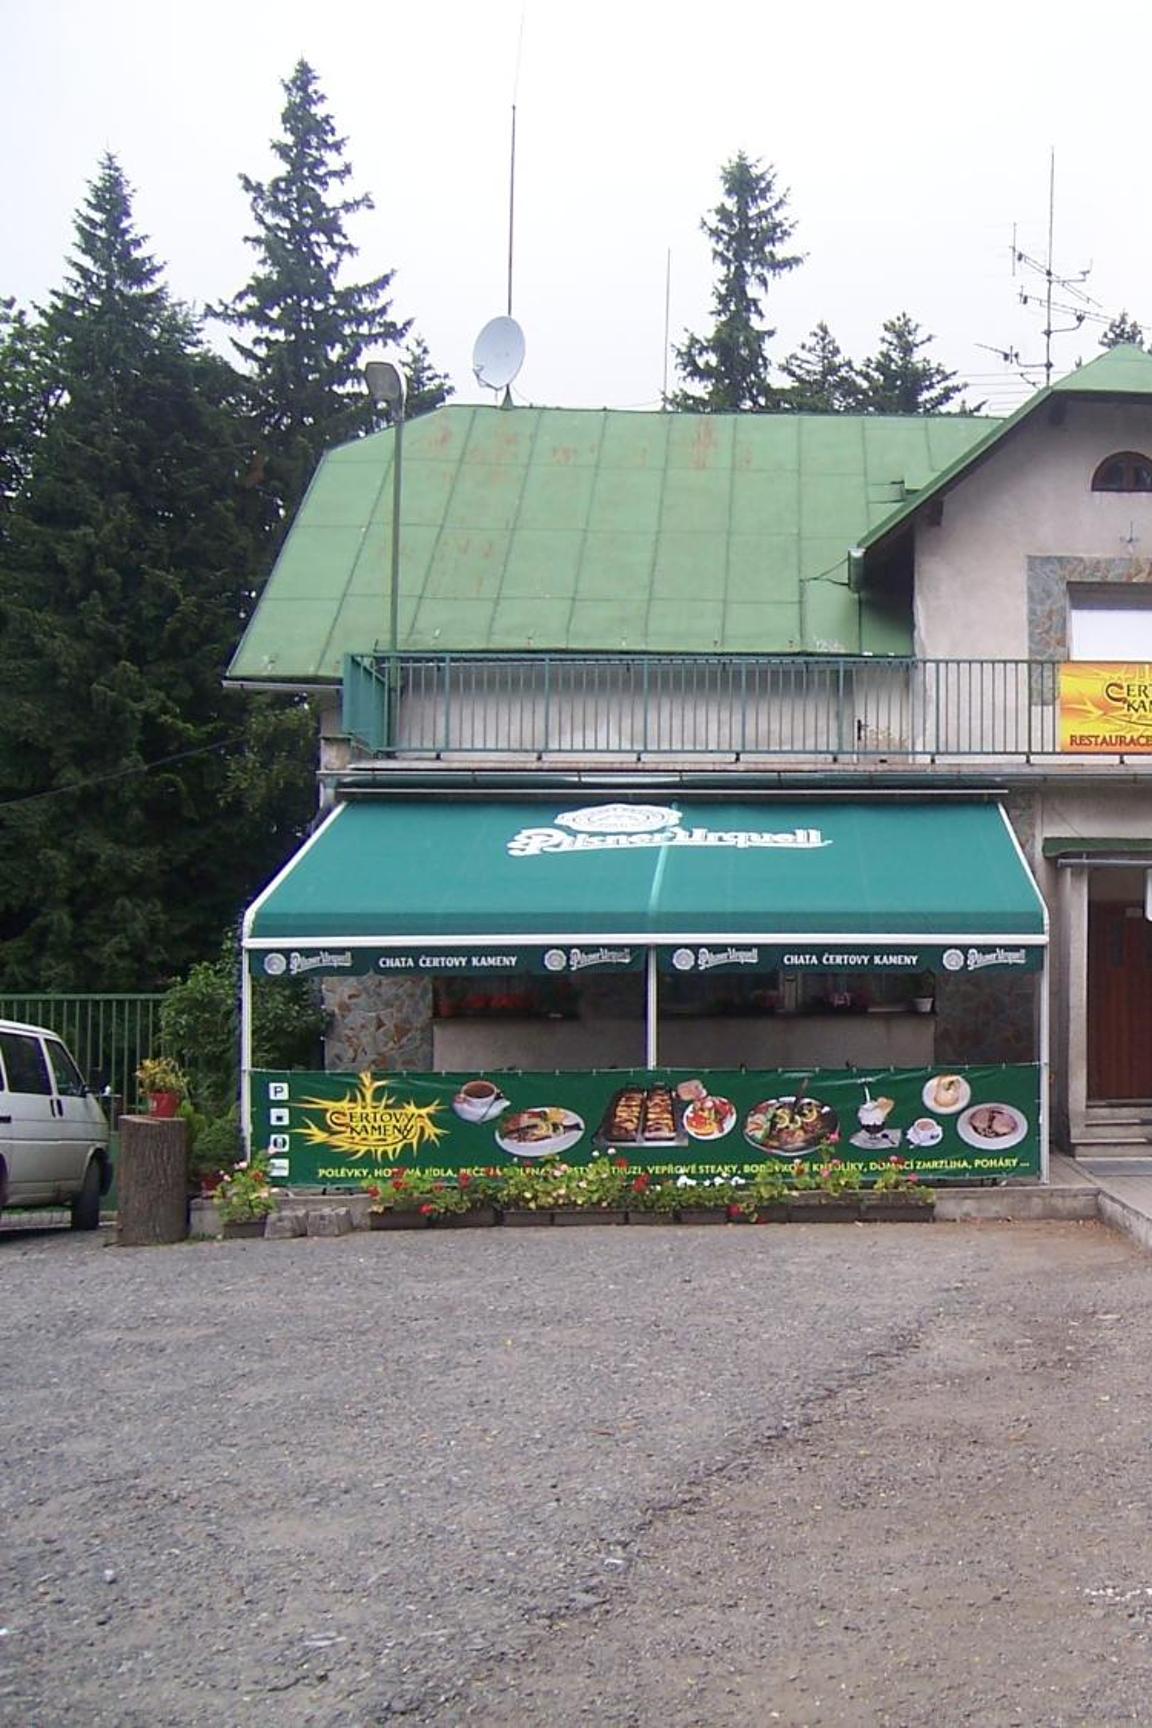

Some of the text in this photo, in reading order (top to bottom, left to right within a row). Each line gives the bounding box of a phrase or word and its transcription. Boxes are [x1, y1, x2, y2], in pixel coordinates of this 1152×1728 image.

[507, 826, 824, 856] Pilsner Urquell
[378, 955, 517, 968] CHATA ČERTOVY KAMENY
[783, 952, 919, 965] CHATA ČERTOVY KAMENY
[349, 1123, 412, 1139] KAMENY
[318, 1166, 372, 1179] POLÉVKY,
[424, 1165, 457, 1179] JÍDLA,
[700, 1164, 741, 1175] STEAKY,
[916, 1158, 972, 1170] ZMRZLINA,
[974, 1156, 1018, 1169] POHÁRY
